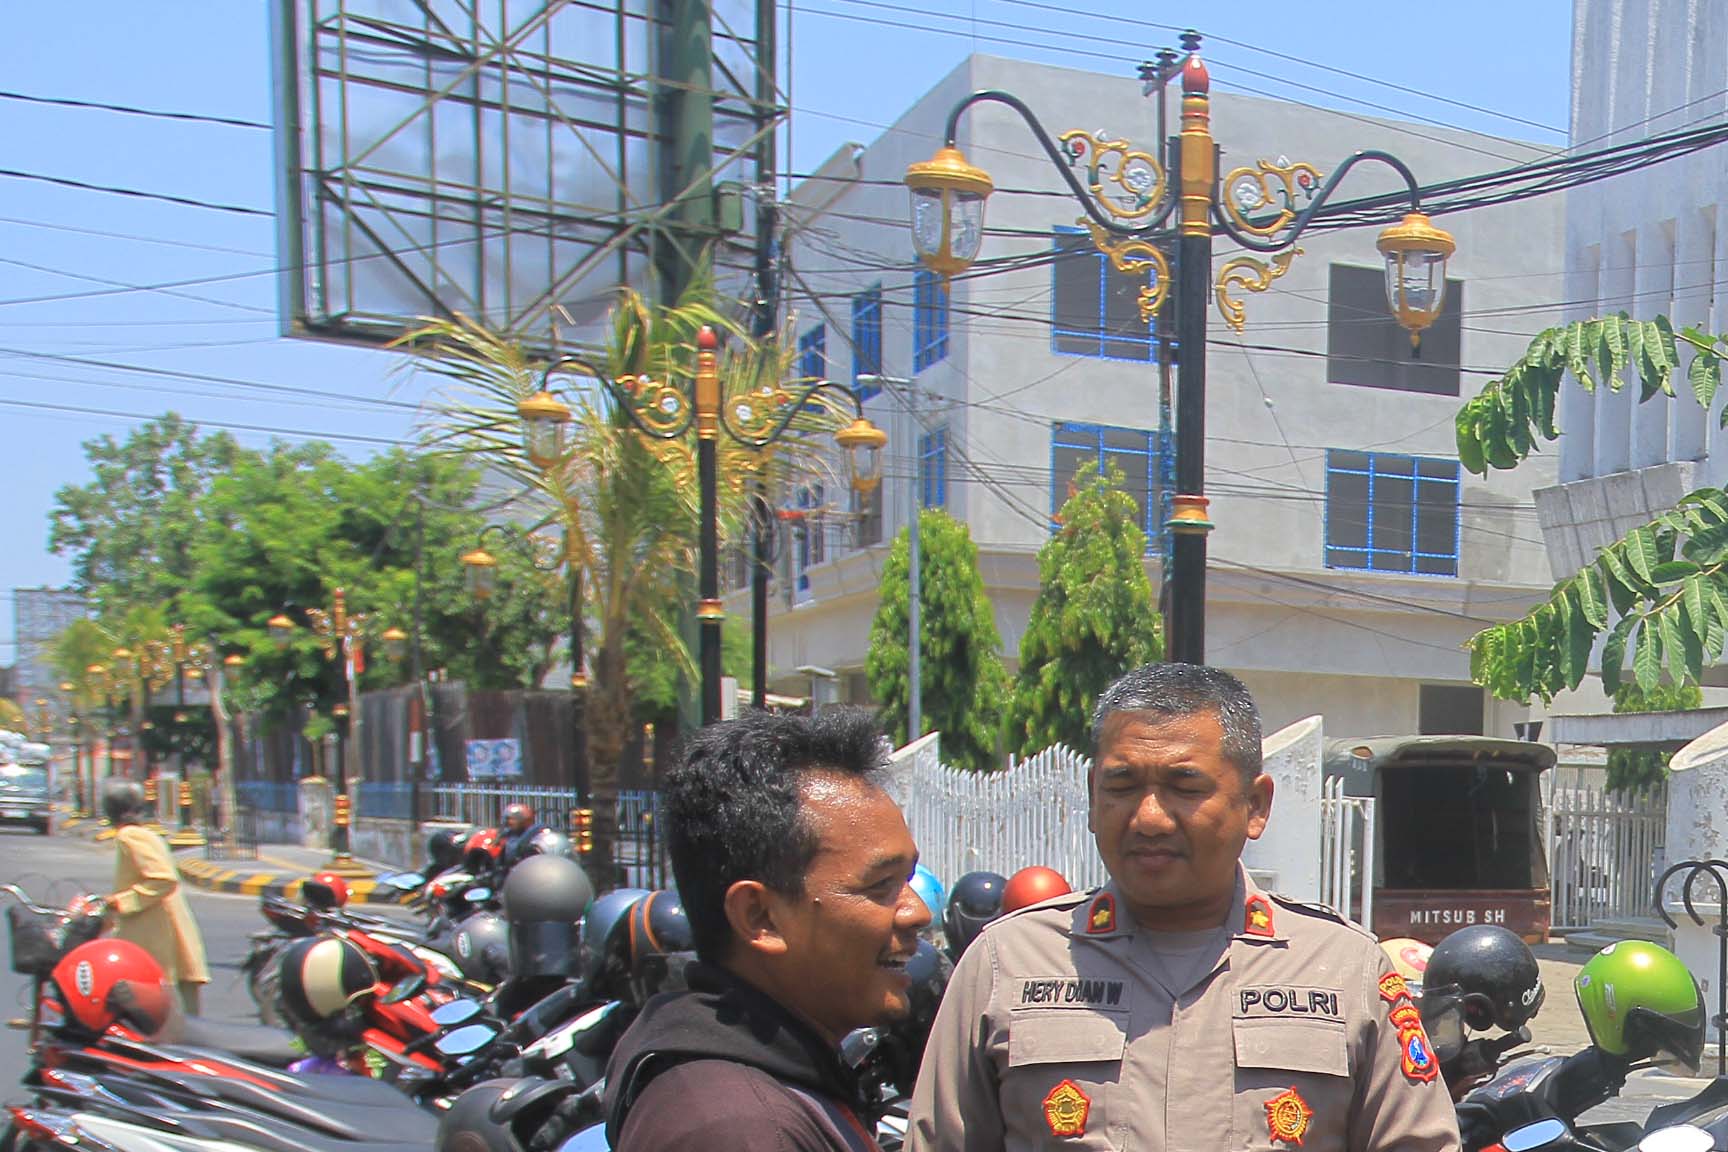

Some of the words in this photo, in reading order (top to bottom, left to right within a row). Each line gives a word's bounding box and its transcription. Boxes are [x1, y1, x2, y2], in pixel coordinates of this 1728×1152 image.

[1021, 980, 1064, 1004] HERY
[1065, 981, 1102, 1004] DIAN
[1103, 982, 1124, 1006] W
[1240, 988, 1338, 1016] POLRI
